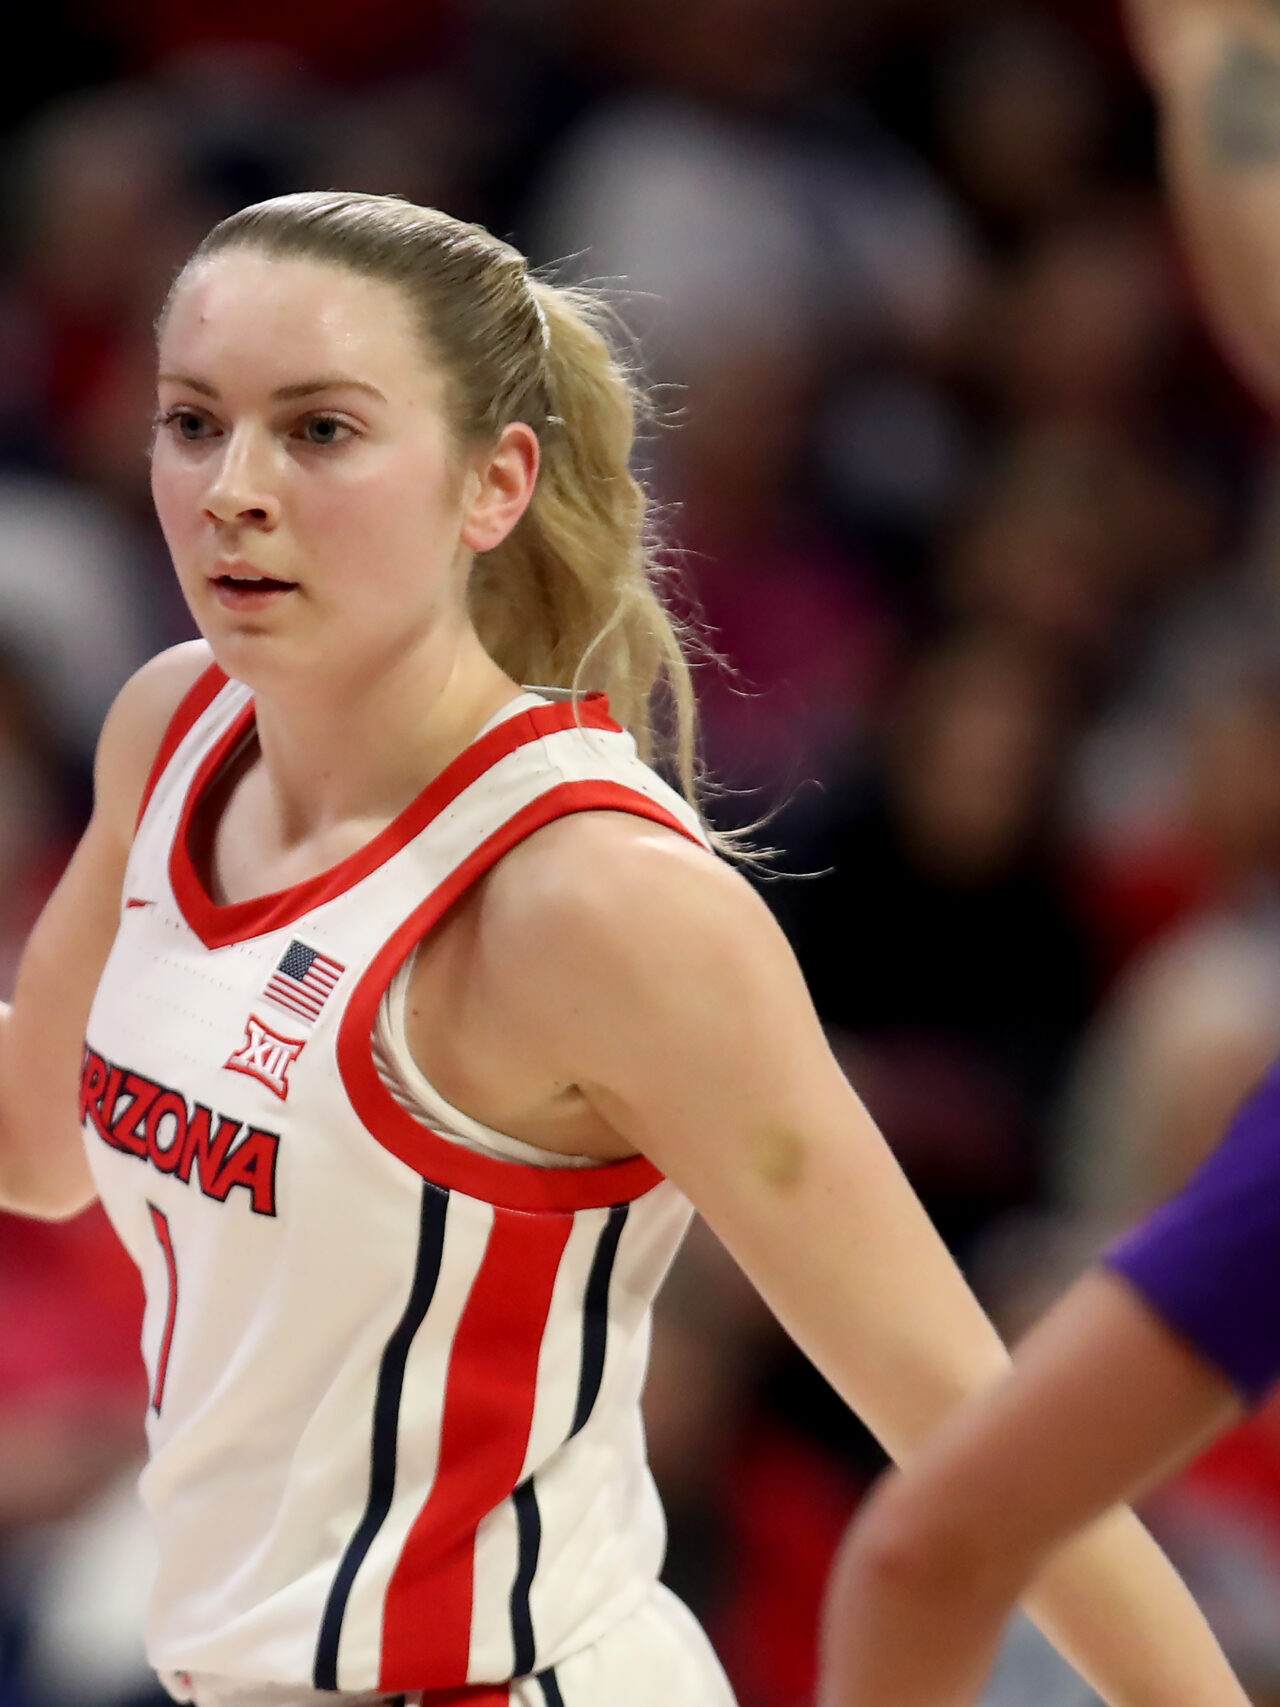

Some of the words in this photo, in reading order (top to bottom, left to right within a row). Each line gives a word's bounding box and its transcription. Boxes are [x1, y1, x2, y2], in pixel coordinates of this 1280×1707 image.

[80, 1042, 280, 1217] RIZONA
[224, 1015, 305, 1099] XII
[146, 1199, 178, 1419] 1
